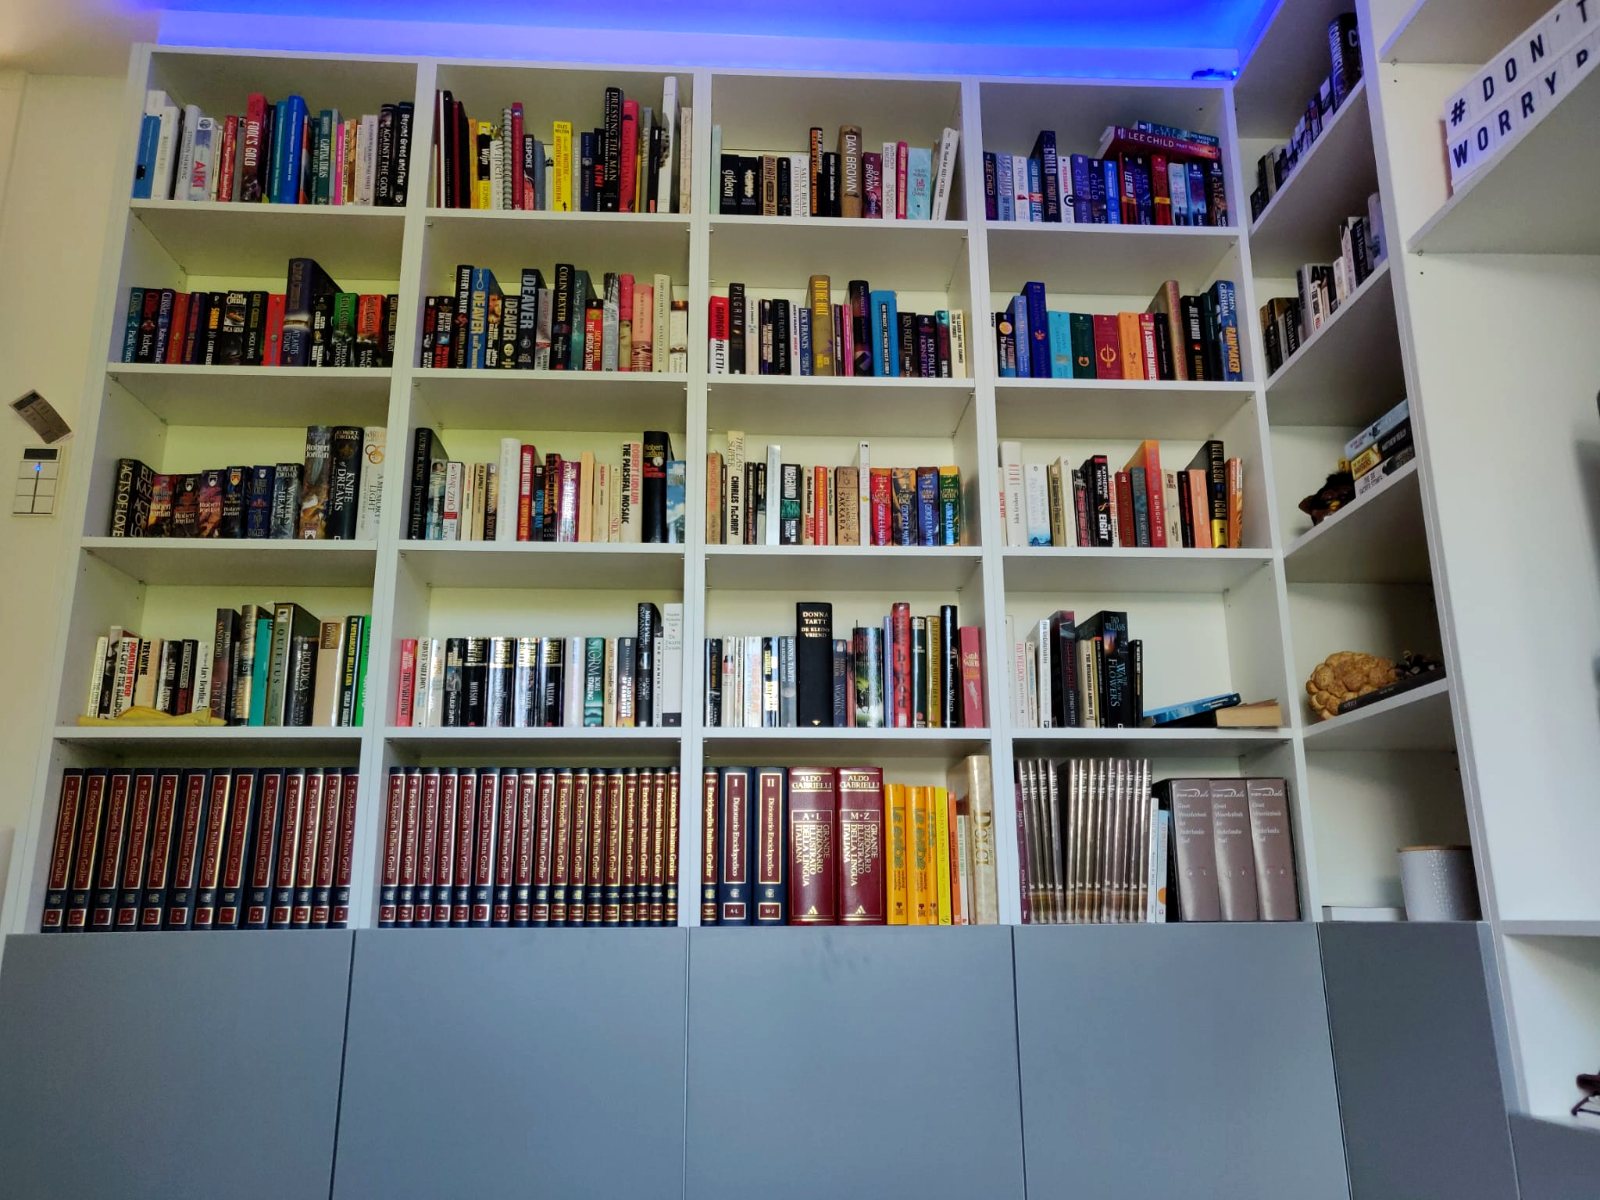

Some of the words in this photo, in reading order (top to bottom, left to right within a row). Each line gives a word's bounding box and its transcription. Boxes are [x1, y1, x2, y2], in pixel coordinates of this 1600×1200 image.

[400, 114, 409, 136] Beyond
[609, 92, 618, 135] DRESSING
[1453, 71, 1557, 168] WORRY
[246, 121, 259, 145] FOOL'S
[382, 128, 391, 159] AGAINST
[846, 134, 856, 154] DAN
[1129, 132, 1144, 141] LEE
[1147, 136, 1174, 148] CHILD
[244, 147, 257, 166] GOLD
[399, 138, 408, 157] Greed
[1044, 147, 1055, 174] CHILD
[381, 161, 389, 175] THE
[398, 159, 406, 170] and
[609, 160, 617, 180] MAN
[846, 157, 856, 192] BROWN
[380, 177, 388, 197] GODS
[397, 172, 405, 186] Fear
[722, 170, 737, 196] gideon
[461, 269, 470, 290] JEFFERY
[558, 267, 568, 290] COLIN
[459, 291, 467, 313] DEAVER
[520, 277, 536, 329] DEAVER
[557, 293, 567, 322] DEXTER
[734, 286, 742, 326] PILGRIM
[815, 290, 828, 301] THE
[471, 294, 485, 334] DEAVER
[503, 302, 518, 341] DEAVER
[816, 303, 828, 316] HILT
[1219, 283, 1229, 316] GRISHAM
[1226, 327, 1240, 372] RAINMAKER
[139, 334, 152, 356] Iceberg
[586, 333, 594, 353] MEDUSA
[716, 340, 725, 369] FALETTI
[623, 444, 631, 457] THE
[631, 444, 640, 473] ROBERT
[1212, 444, 1222, 458] NEIL
[119, 465, 132, 492] ACTS
[622, 458, 631, 493] PARSIFAL
[1213, 461, 1223, 483] OLSON
[117, 494, 129, 508] OF
[334, 468, 346, 511] DREAMS
[344, 472, 355, 503] KNIFE
[630, 474, 640, 505] LUDLUM
[276, 491, 285, 518] HEART
[621, 495, 630, 524] MOSAIC
[1215, 500, 1225, 518] ICON
[112, 510, 127, 537] LOVE
[730, 506, 739, 536] McCARRY
[1099, 514, 1108, 540] EIGHT
[127, 641, 137, 675] JONATHAN
[140, 641, 151, 676] TREVAYNE
[273, 628, 284, 685] QUIETUS
[588, 639, 602, 676] STORM
[300, 651, 311, 691] BOUDICA
[1108, 658, 1120, 707] FLOWERS
[124, 676, 133, 698] RYDER
[212, 681, 222, 712] PREY
[469, 681, 479, 706] MONSOON
[732, 797, 740, 831] Dizionario
[767, 798, 775, 831] Dizionario
[850, 824, 858, 852] DELLA
[731, 832, 740, 876] Enciclopedico
[766, 832, 775, 876] Enciclopedico
[850, 854, 858, 886] LINGUA
